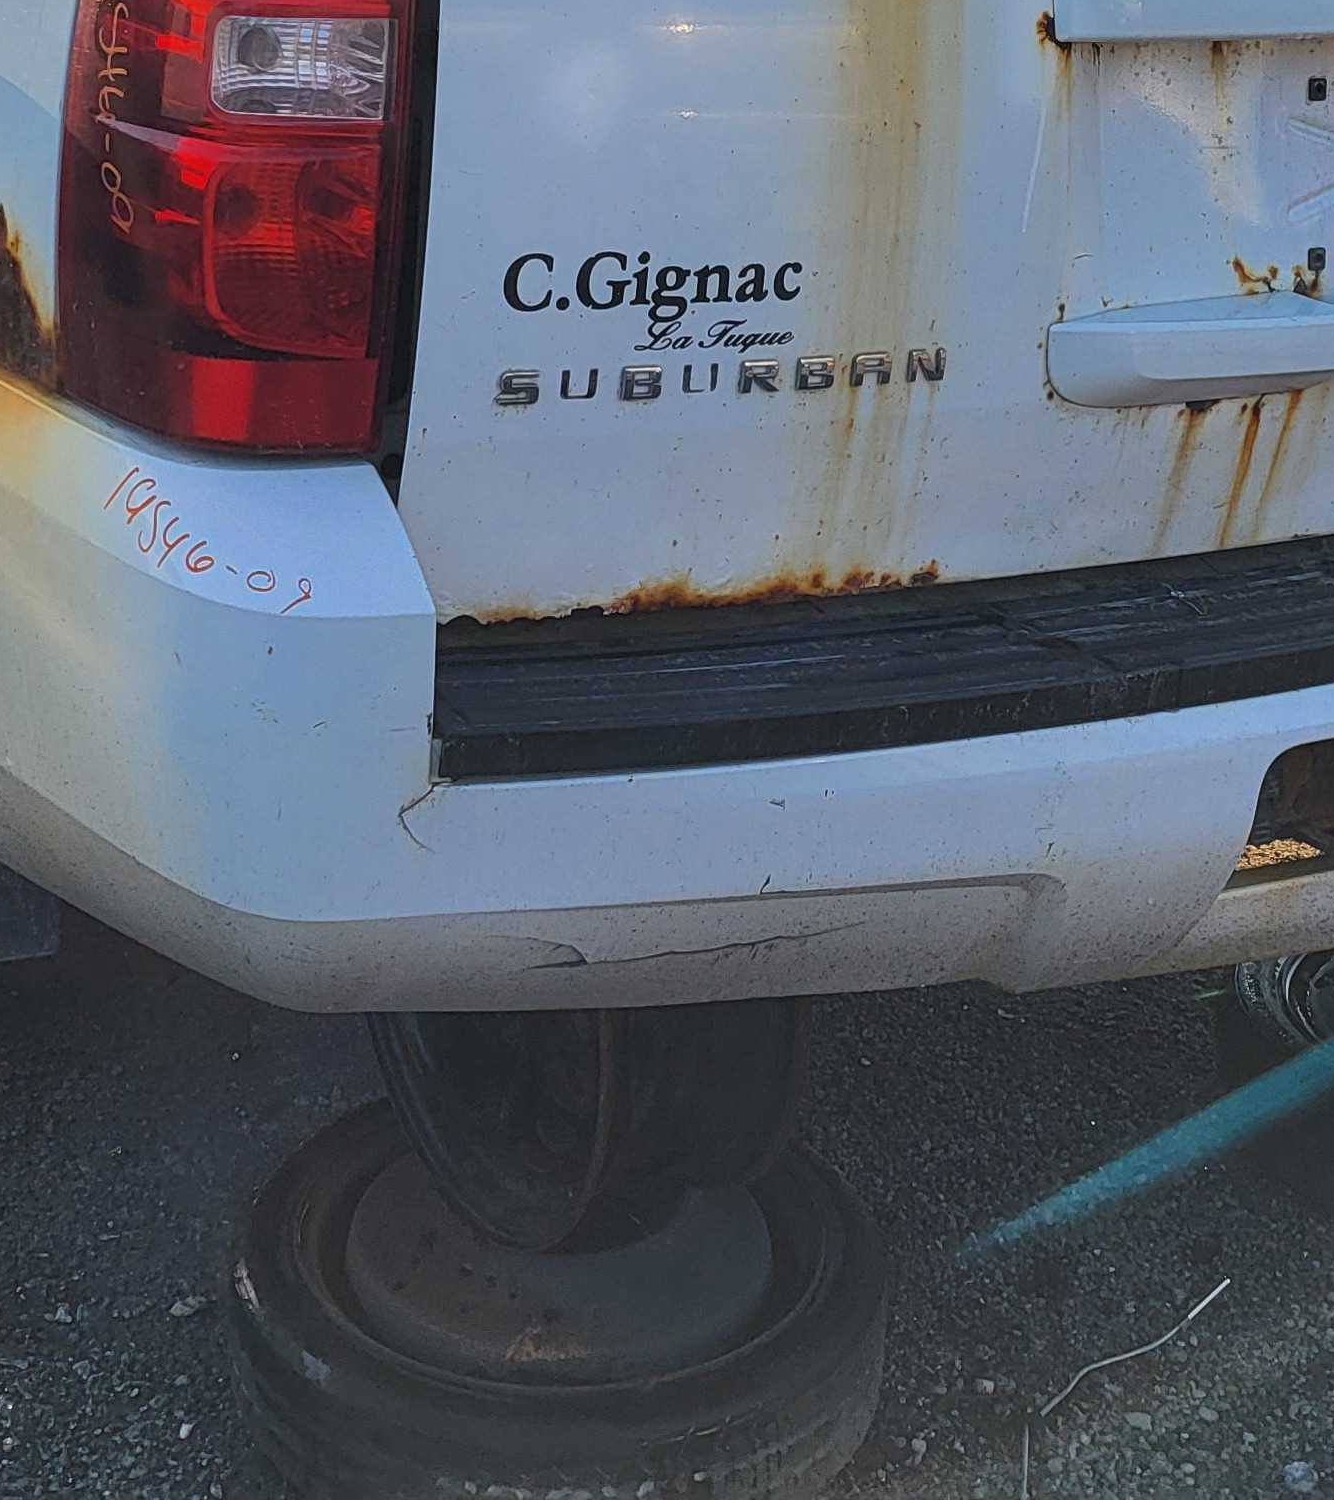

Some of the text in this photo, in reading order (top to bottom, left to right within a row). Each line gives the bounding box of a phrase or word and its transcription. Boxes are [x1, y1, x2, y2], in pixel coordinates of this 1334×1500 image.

[502, 250, 804, 323] C.Gignac
[634, 318, 795, 354] La Tuque
[493, 346, 947, 407] SUBURBAN
